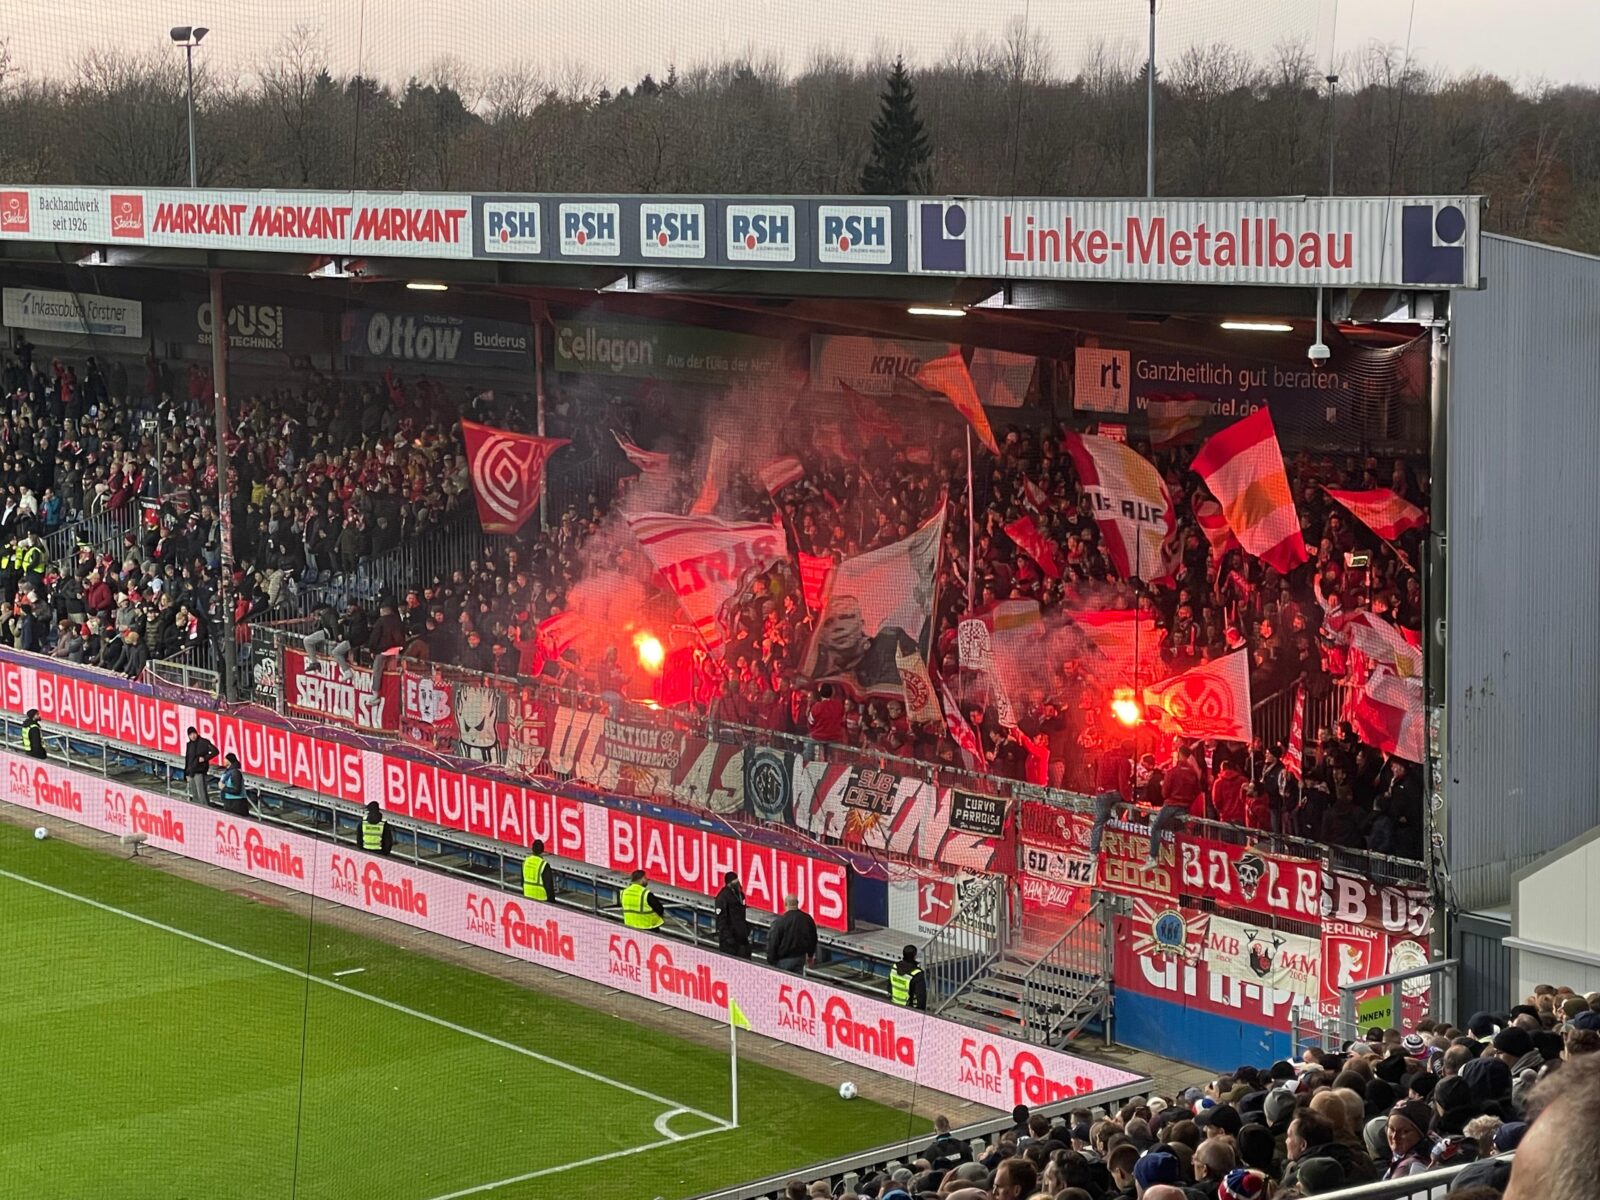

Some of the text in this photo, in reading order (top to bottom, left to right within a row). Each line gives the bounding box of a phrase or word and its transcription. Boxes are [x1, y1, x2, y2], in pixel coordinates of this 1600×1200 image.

[39, 196, 100, 212] Backhandwerk
[152, 203, 247, 236] MARKANT
[52, 217, 88, 232] seit 1926
[248, 205, 352, 240] MARKANT
[352, 207, 467, 243] MARKANT
[488, 211, 536, 238] RSH
[564, 212, 615, 240] RSH
[645, 212, 699, 242] RSH
[732, 214, 789, 244] RSH
[824, 215, 885, 246] RSH
[1003, 215, 1353, 270] Linke-Metallbau
[367, 311, 462, 361] Ottow
[473, 331, 527, 349] Buderus
[558, 327, 654, 372] Cellagon
[1100, 356, 1121, 390] rt
[1136, 359, 1233, 385] Ganzheitlich
[1238, 368, 1267, 391] gut
[39, 677, 179, 746] BAUHAUS
[604, 718, 660, 750] SEKTION
[199, 717, 362, 794] BAUHAUS
[9, 762, 30, 785] 50
[32, 766, 83, 813] famila
[858, 769, 896, 793] SUB
[104, 789, 126, 814] 50
[386, 763, 583, 851] BAUHAUS
[964, 797, 996, 813] CURVA
[129, 794, 185, 844] famila
[215, 820, 240, 848] 50
[243, 827, 304, 880] famila
[1100, 830, 1176, 868] RHEN
[331, 853, 358, 882] 50
[612, 818, 844, 920] BAUHAUS
[1028, 850, 1092, 882] SD MZ
[1105, 858, 1172, 893] GOLD
[361, 861, 428, 917] famila
[466, 892, 496, 923] 50
[466, 916, 497, 939] JAHRE
[500, 901, 575, 962] famila
[608, 933, 641, 966] 50
[1210, 932, 1240, 956] MB
[608, 960, 642, 983] JAHRE
[646, 943, 729, 1009] famila
[1279, 949, 1318, 977] MM
[777, 983, 816, 1020] 50
[1359, 1008, 1392, 1024] INNEN 9
[777, 1010, 816, 1037] JAHRE
[821, 995, 916, 1068] famila
[959, 1038, 1001, 1076] 50
[958, 1064, 1002, 1094] JAHRE
